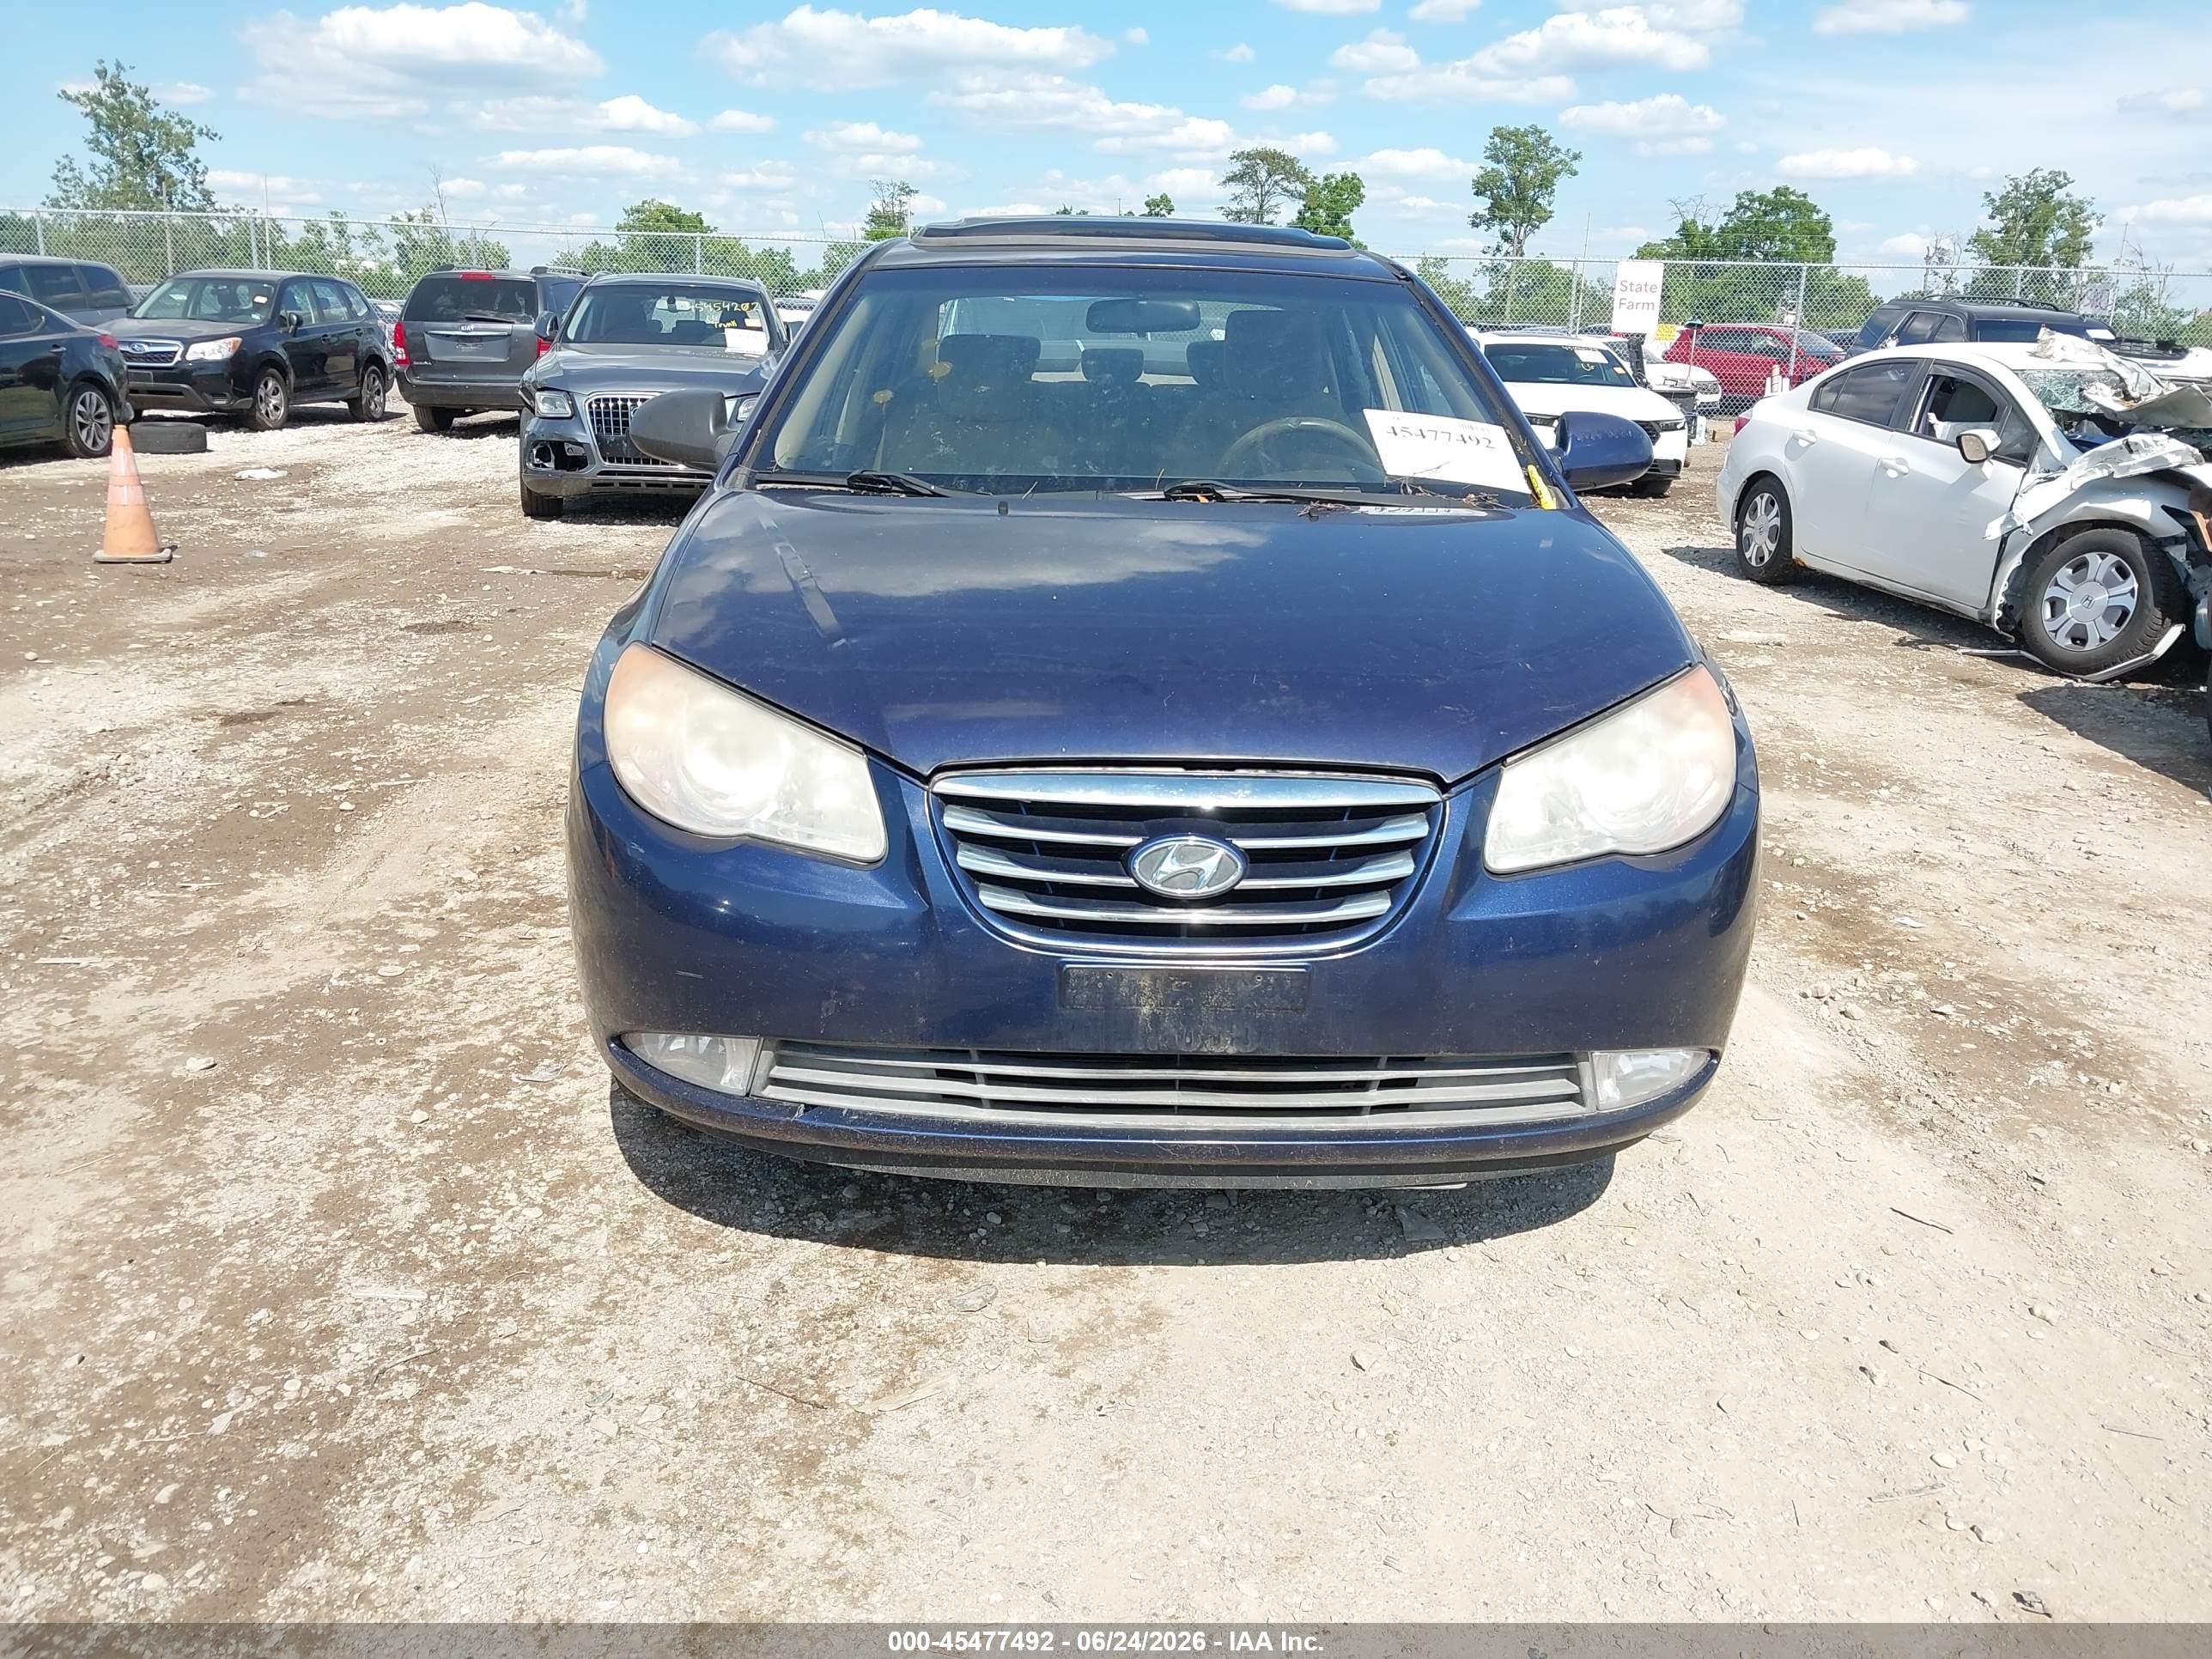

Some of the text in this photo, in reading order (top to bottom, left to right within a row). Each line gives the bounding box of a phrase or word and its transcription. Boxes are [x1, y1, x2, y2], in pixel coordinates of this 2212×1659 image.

[1620, 280, 1658, 293] State
[1619, 298, 1656, 311] Farm
[1386, 425, 1496, 449] 45477492
